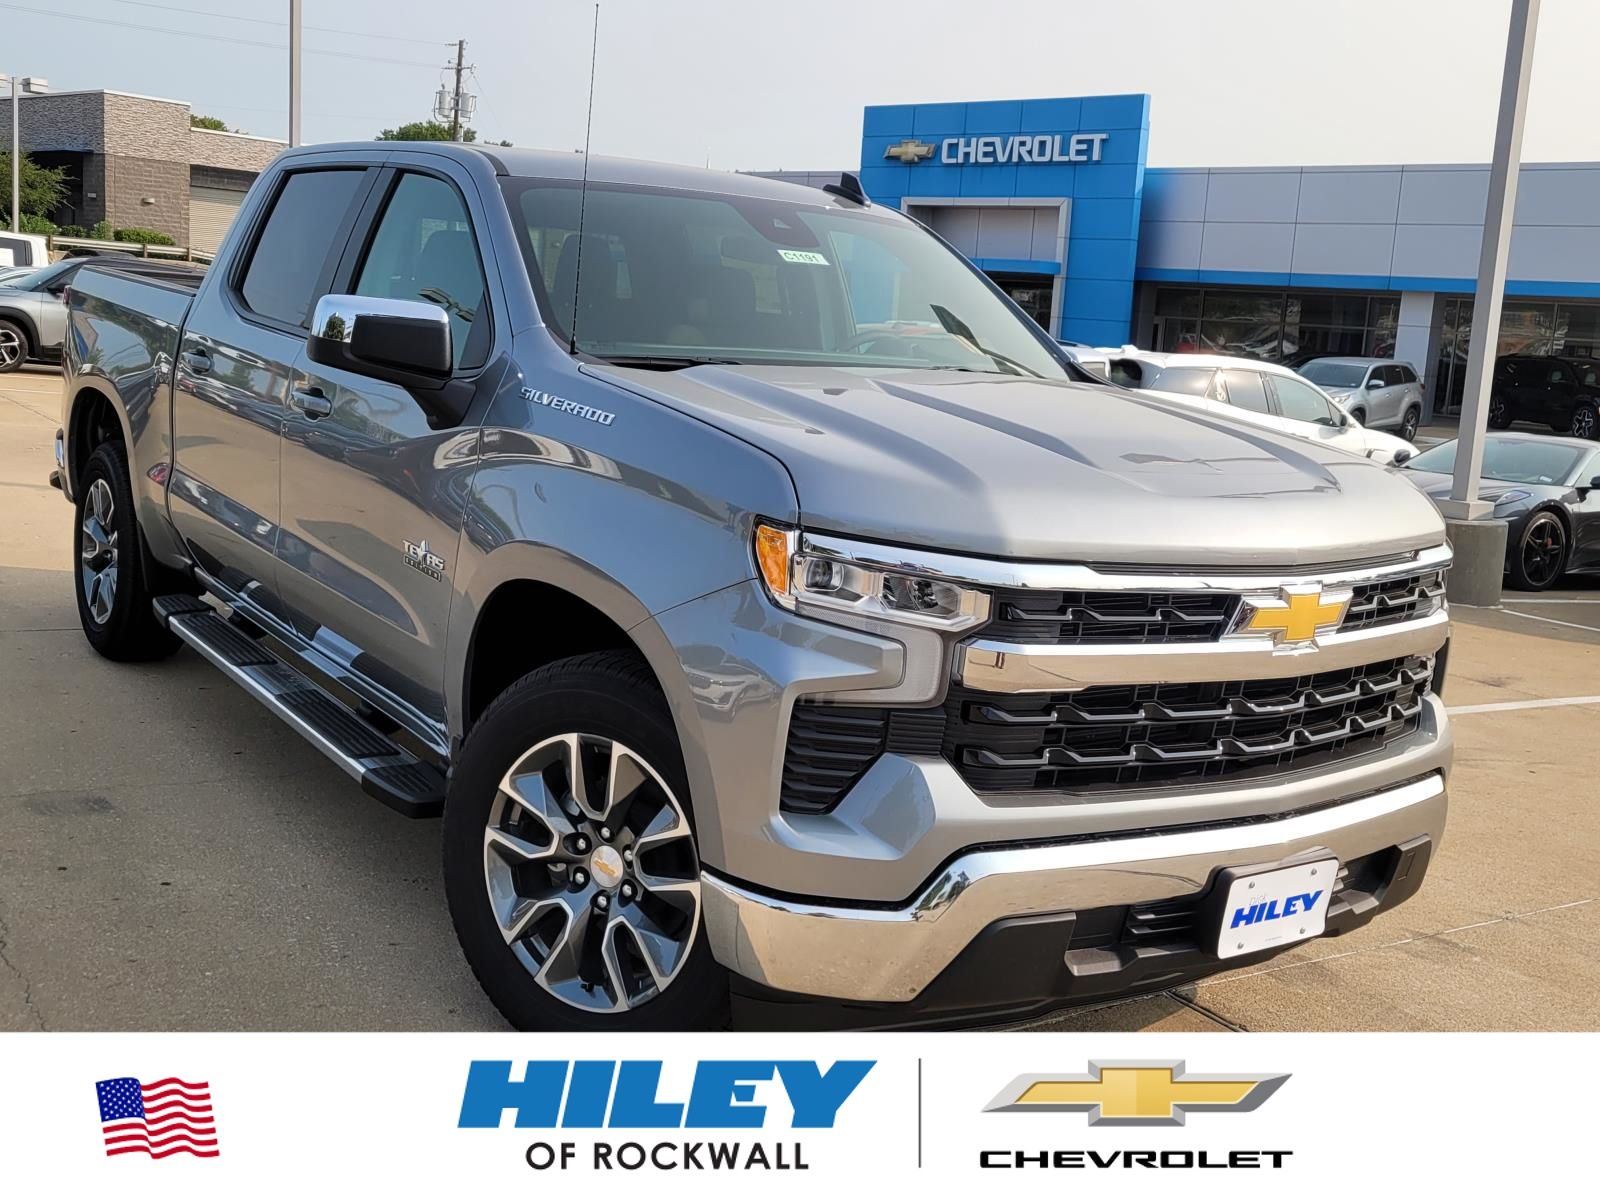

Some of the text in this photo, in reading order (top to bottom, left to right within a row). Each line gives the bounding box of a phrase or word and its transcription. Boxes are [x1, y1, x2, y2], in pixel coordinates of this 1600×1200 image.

[941, 133, 1109, 164] CHEVROLET
[783, 252, 820, 263] C1191
[520, 386, 616, 427] SILVERADO
[402, 539, 445, 570] TEXAS
[1230, 889, 1324, 929] HILEY
